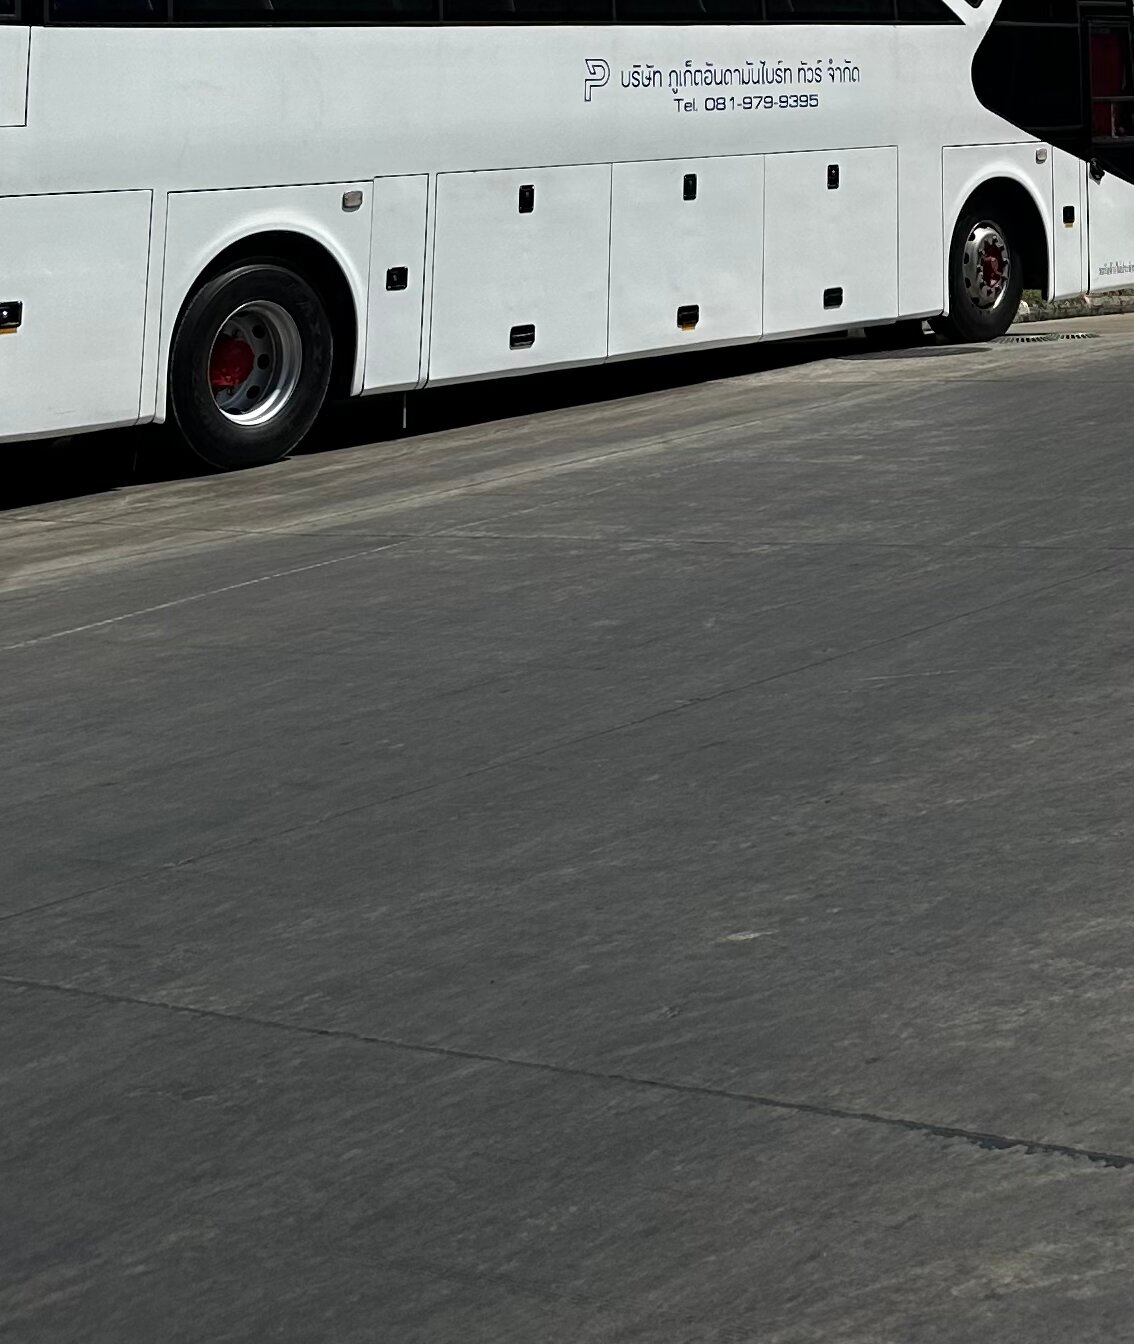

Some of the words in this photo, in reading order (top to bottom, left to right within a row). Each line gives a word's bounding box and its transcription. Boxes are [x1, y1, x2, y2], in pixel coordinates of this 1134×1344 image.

[621, 64, 662, 88] บริษัท
[668, 60, 792, 94] ภูเก็ตอันดามันไบร์ท
[797, 59, 822, 83] ทัวร์
[827, 58, 860, 83] จำกัด
[704, 94, 819, 111] 081-979-9395
